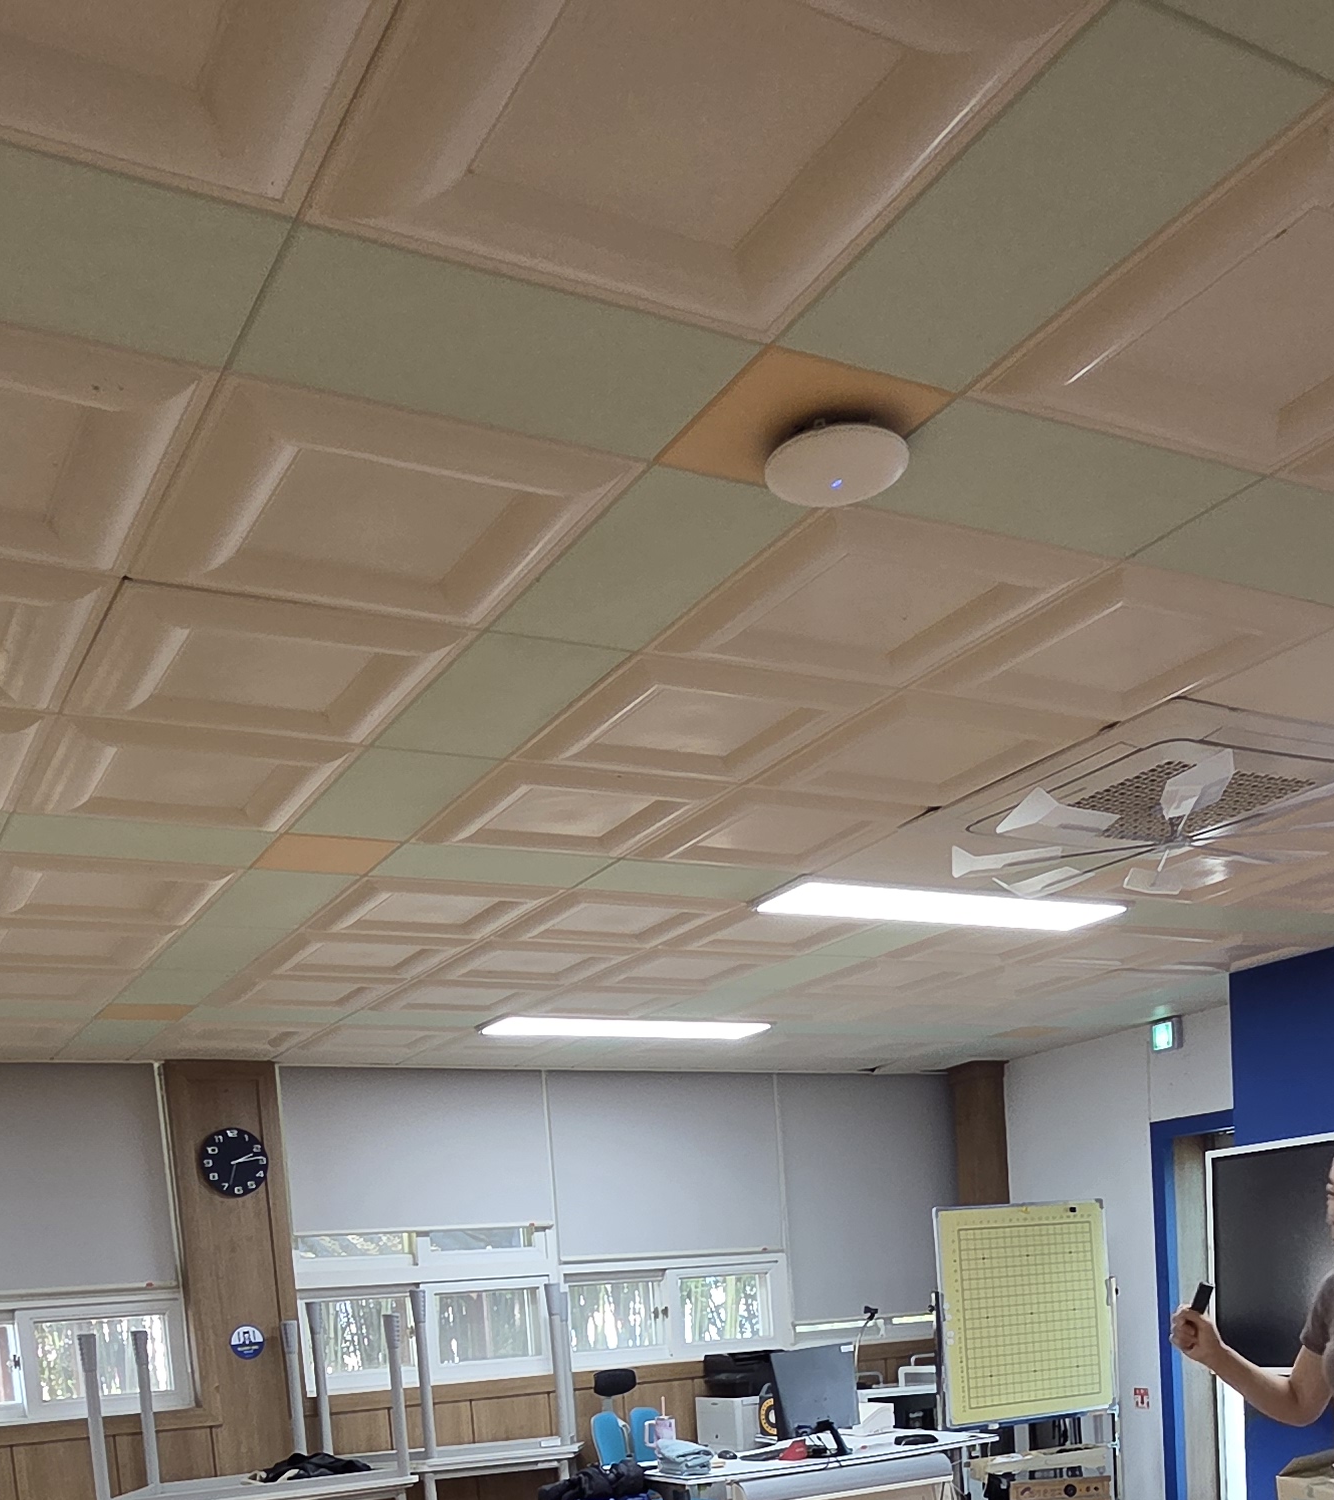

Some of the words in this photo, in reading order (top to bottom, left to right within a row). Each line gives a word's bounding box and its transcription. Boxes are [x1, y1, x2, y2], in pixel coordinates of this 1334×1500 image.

[226, 1129, 238, 1138] 12
[244, 1134, 249, 1142] 1
[214, 1135, 224, 1143] 11
[206, 1146, 219, 1155] 10
[252, 1144, 262, 1153] 2
[203, 1159, 213, 1168] 9
[255, 1170, 264, 1178] 4
[221, 1182, 229, 1191] 7
[247, 1181, 256, 1189] 5
[234, 1186, 244, 1195] 6
